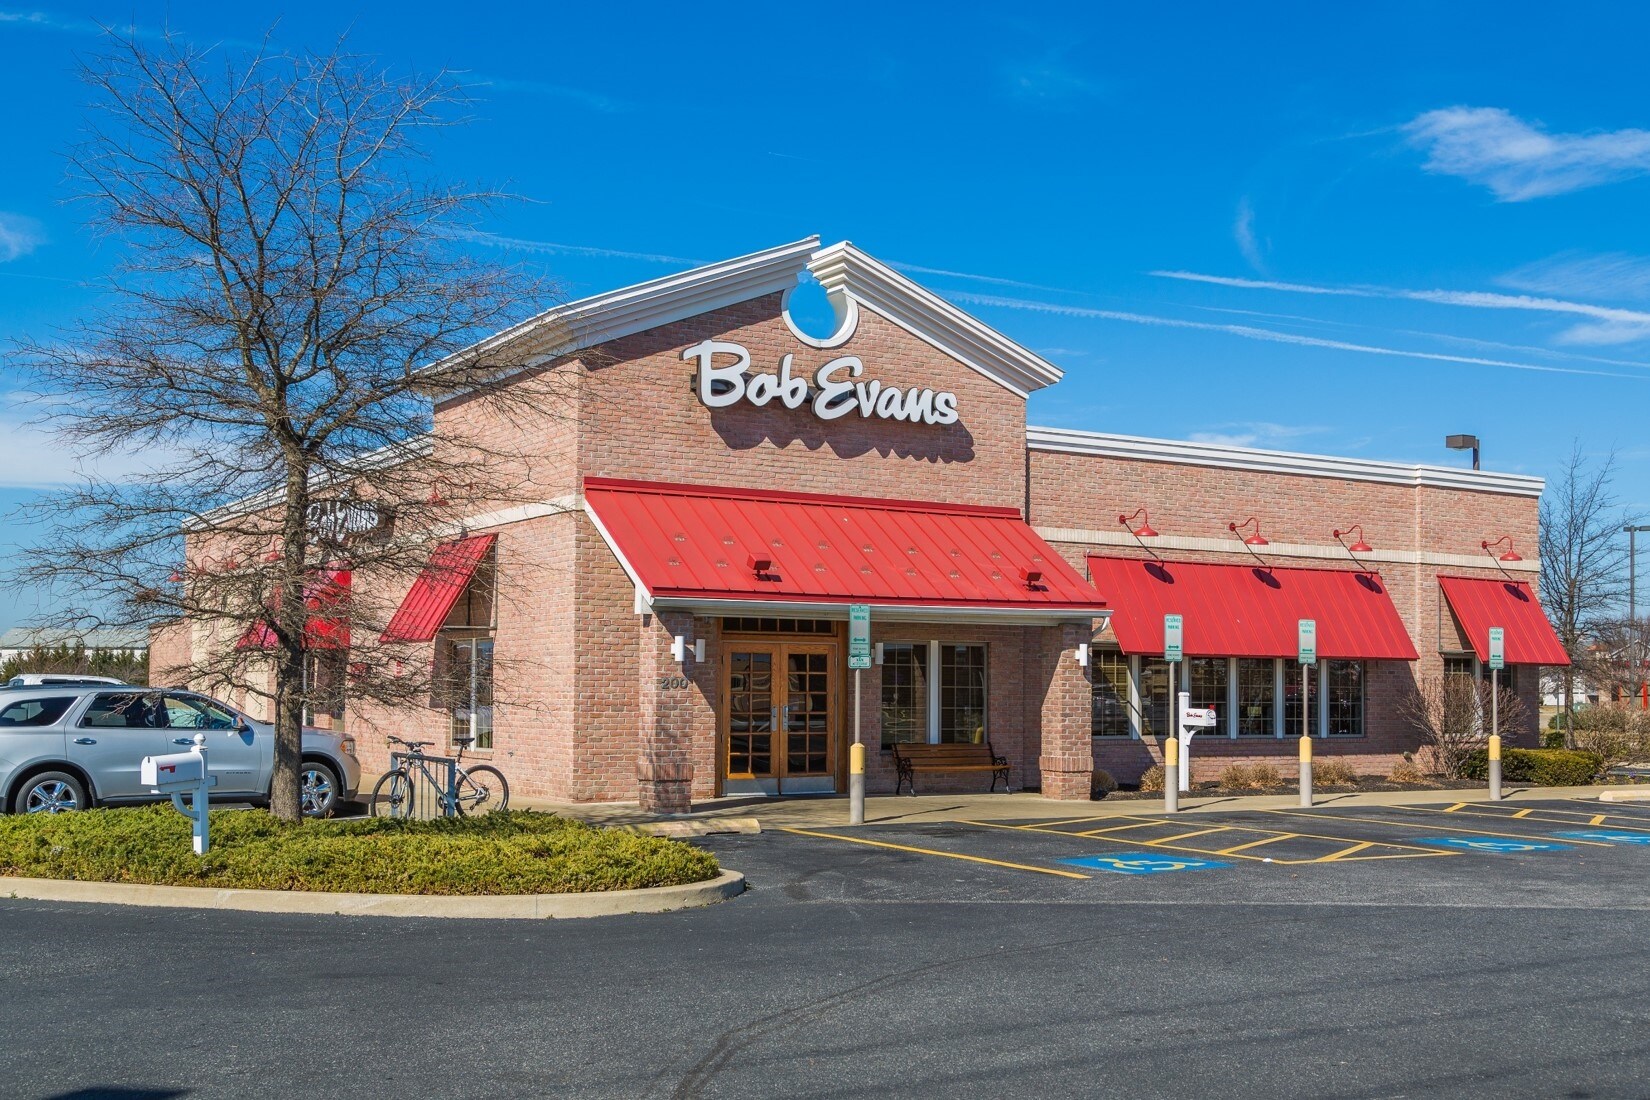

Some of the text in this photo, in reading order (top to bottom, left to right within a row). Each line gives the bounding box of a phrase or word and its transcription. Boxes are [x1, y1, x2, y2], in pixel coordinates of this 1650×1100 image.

[680, 339, 959, 425] Bob Evans
[661, 676, 688, 690] 200
